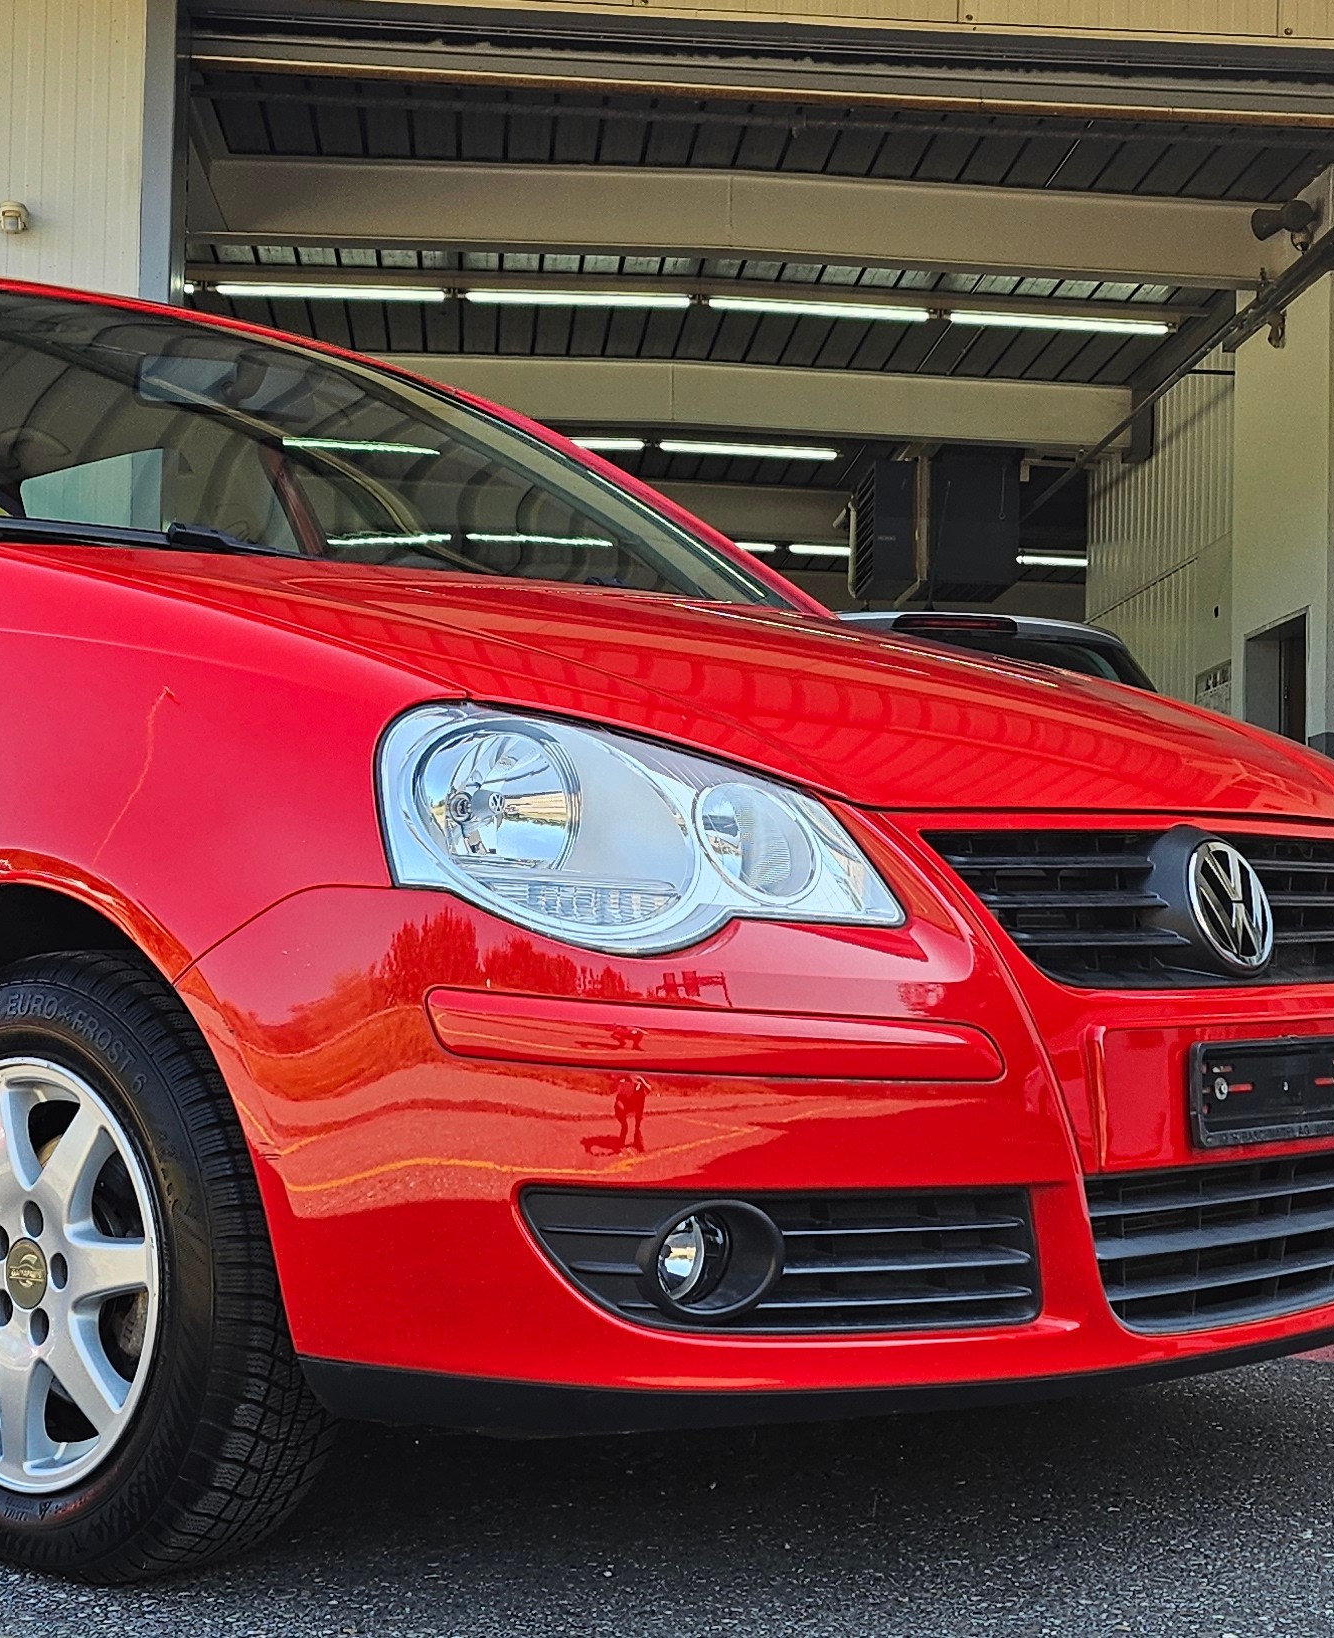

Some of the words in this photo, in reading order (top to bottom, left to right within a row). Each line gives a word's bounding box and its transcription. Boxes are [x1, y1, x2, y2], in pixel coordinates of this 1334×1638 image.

[6, 993, 58, 1020] EURO
[71, 1010, 137, 1074] FROST
[130, 1073, 147, 1094] 6
